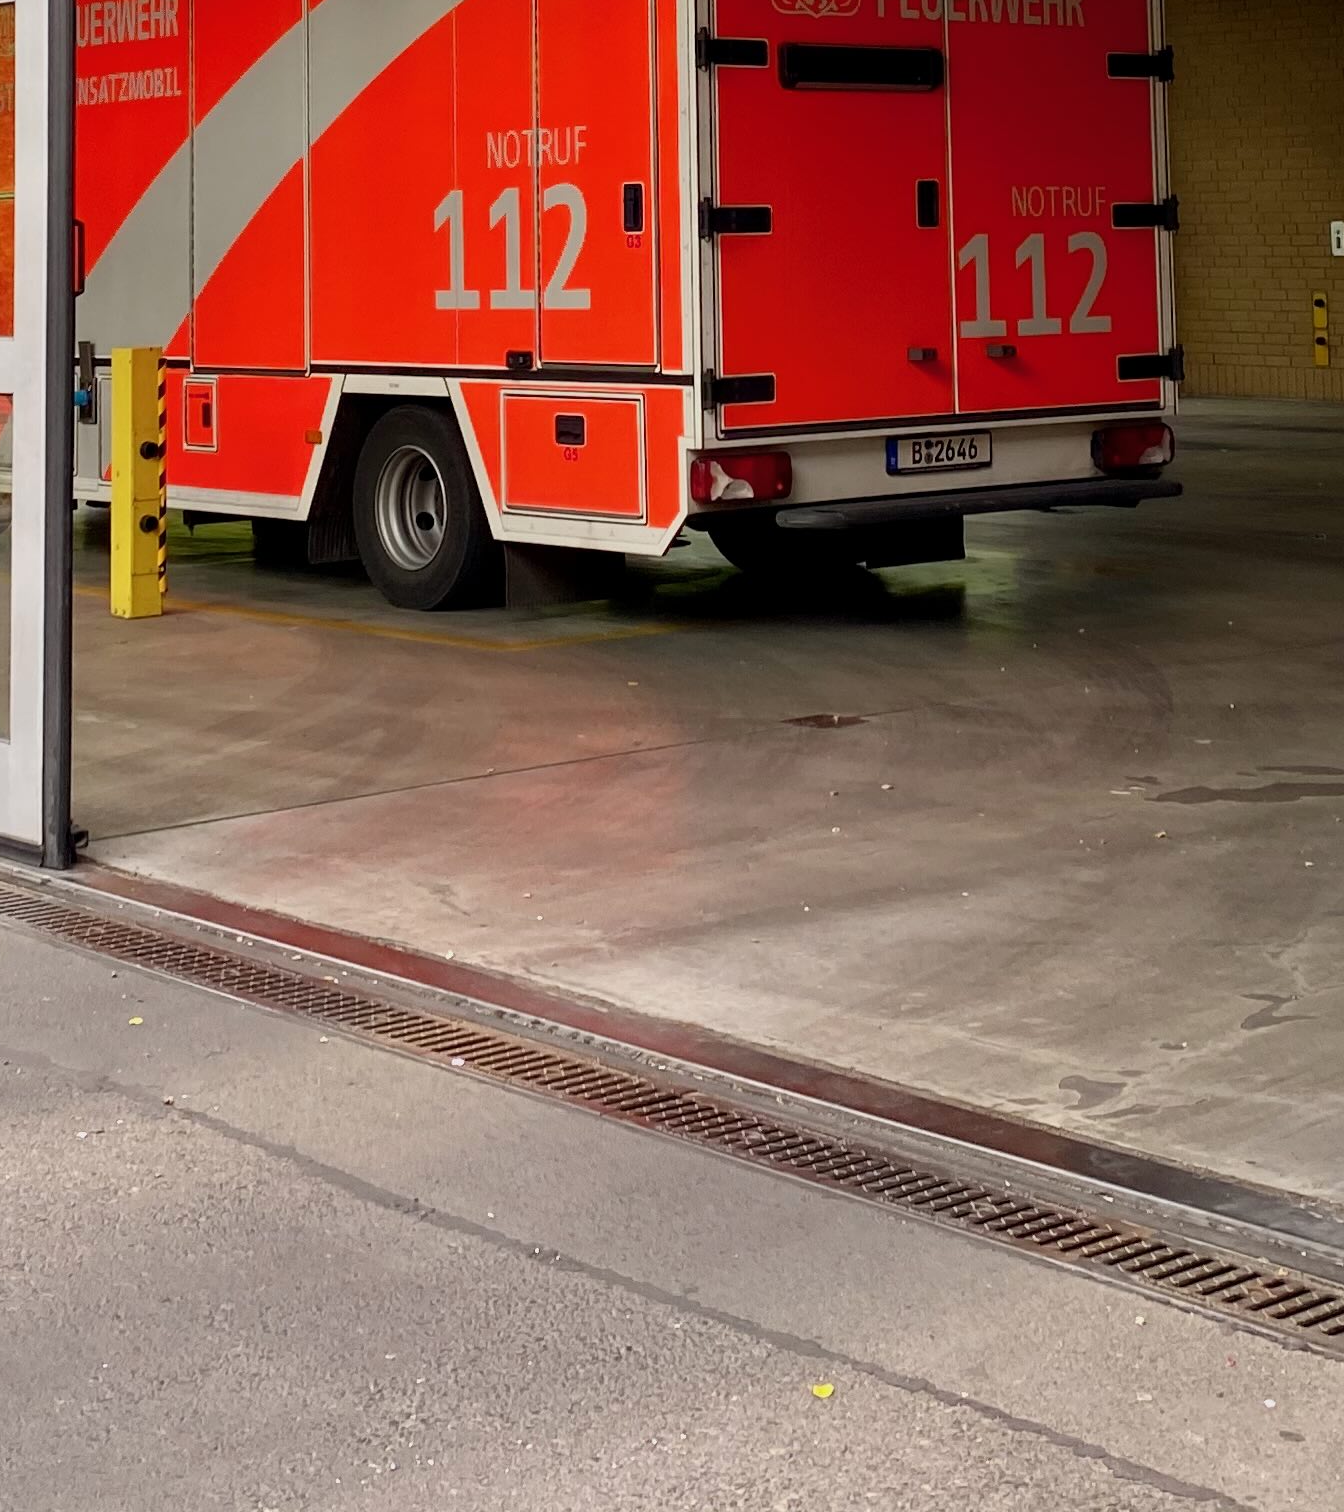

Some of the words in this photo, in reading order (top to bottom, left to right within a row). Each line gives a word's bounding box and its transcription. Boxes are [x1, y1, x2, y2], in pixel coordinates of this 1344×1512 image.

[76, 67, 182, 106] NSATZMOBIL
[486, 125, 588, 169] NOTRUF
[1011, 185, 1107, 218] NOTRUF
[433, 183, 592, 311] 112
[958, 231, 1113, 339] 112
[912, 441, 923, 464] B
[934, 437, 978, 463] 2646
